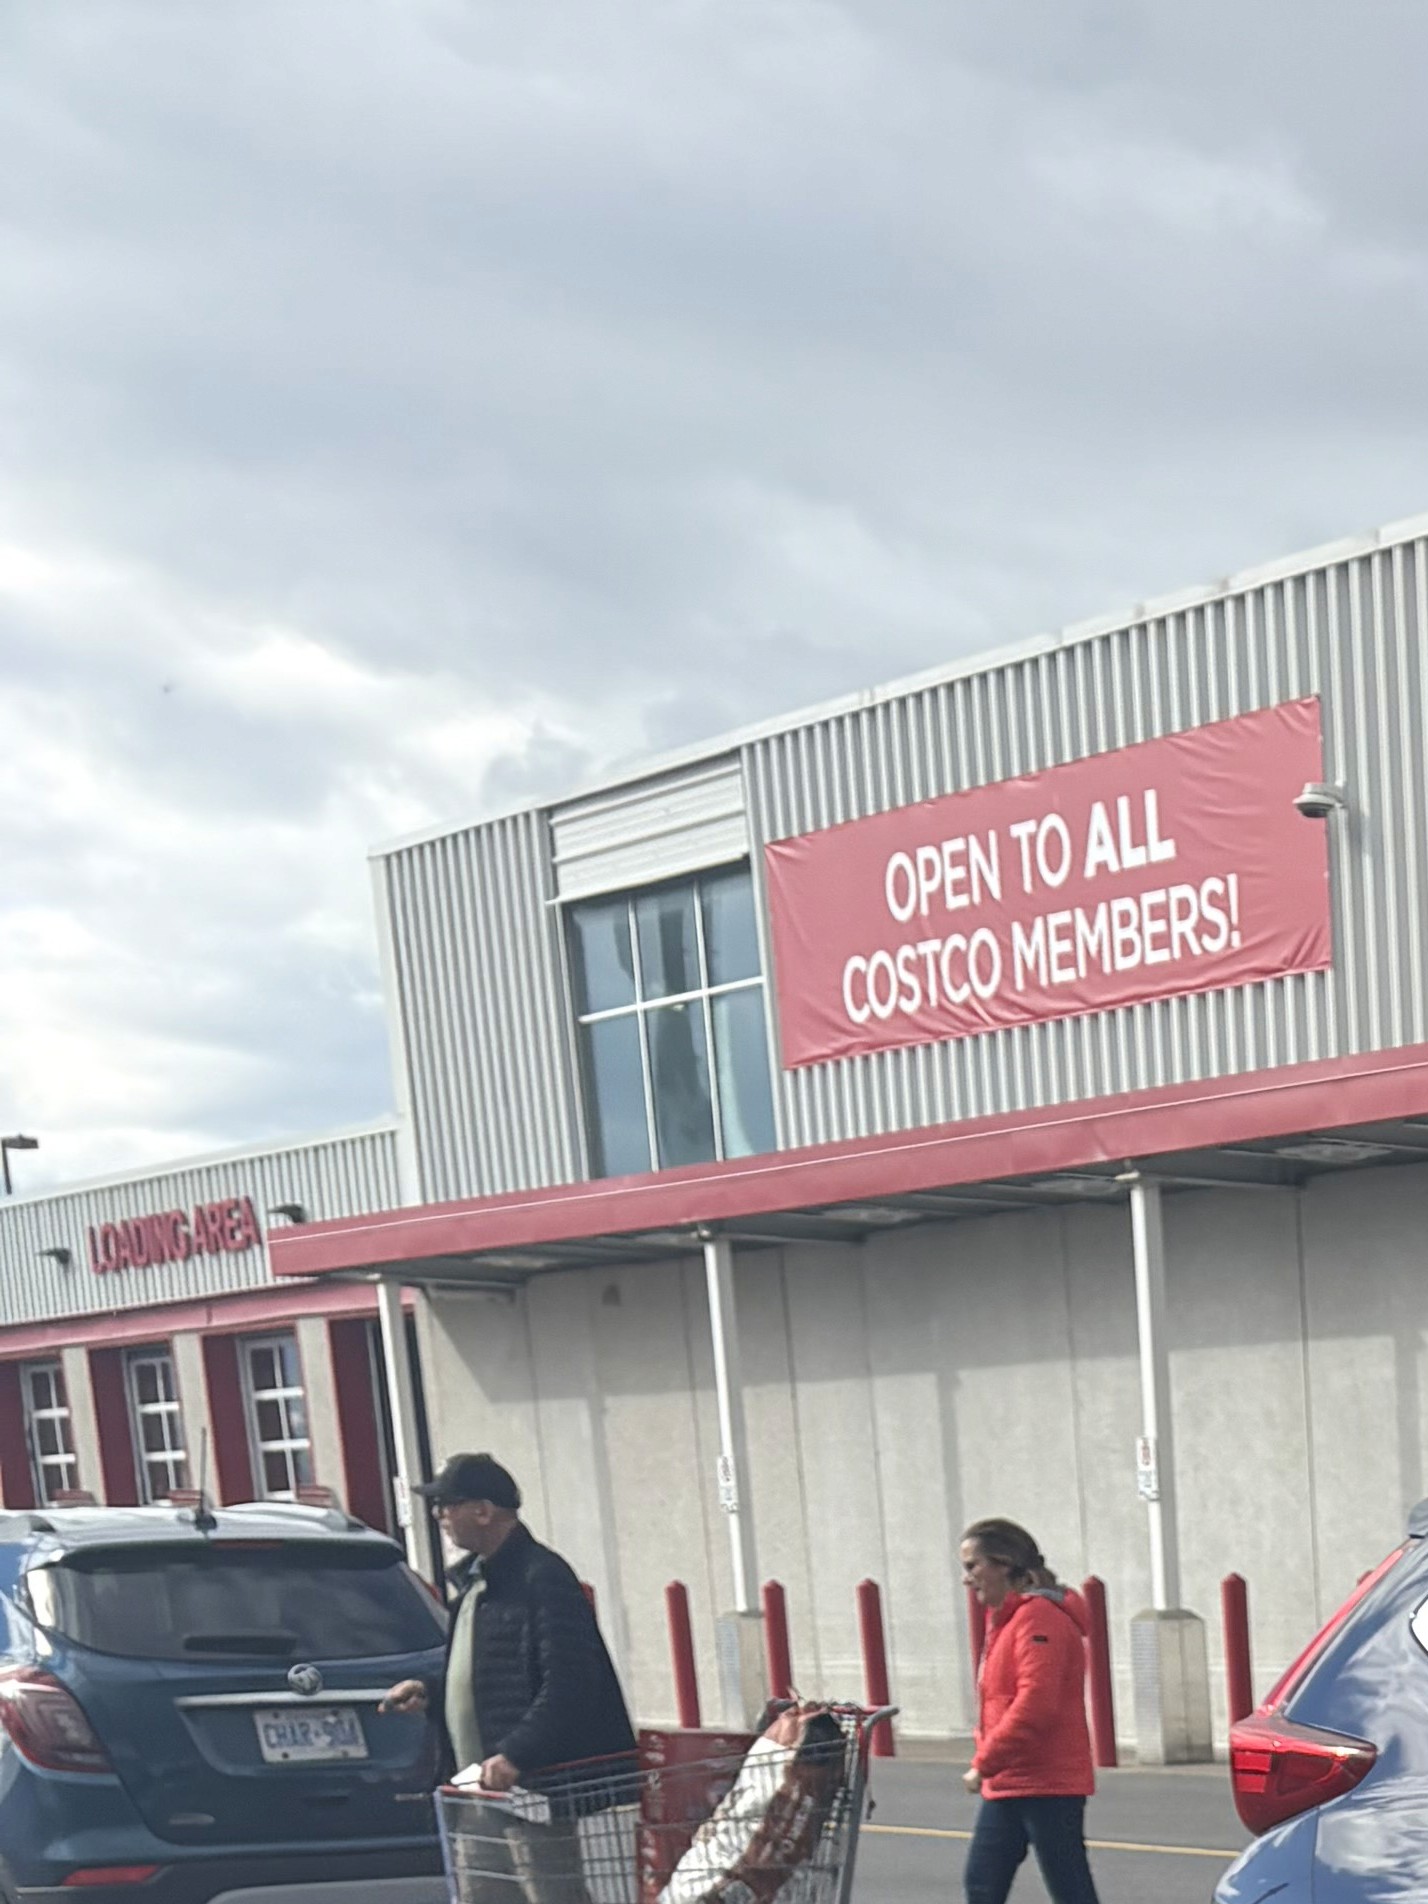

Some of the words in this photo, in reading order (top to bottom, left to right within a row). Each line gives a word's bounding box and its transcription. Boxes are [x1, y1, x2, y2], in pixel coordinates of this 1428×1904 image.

[885, 829, 1002, 922] OPEN
[1010, 813, 1071, 894] TO
[1084, 789, 1177, 878] ALL
[842, 927, 1002, 1024] COSTCO
[1012, 873, 1241, 992] MEMBERS!
[88, 1208, 192, 1275] LOADING
[190, 1195, 262, 1257] AREA
